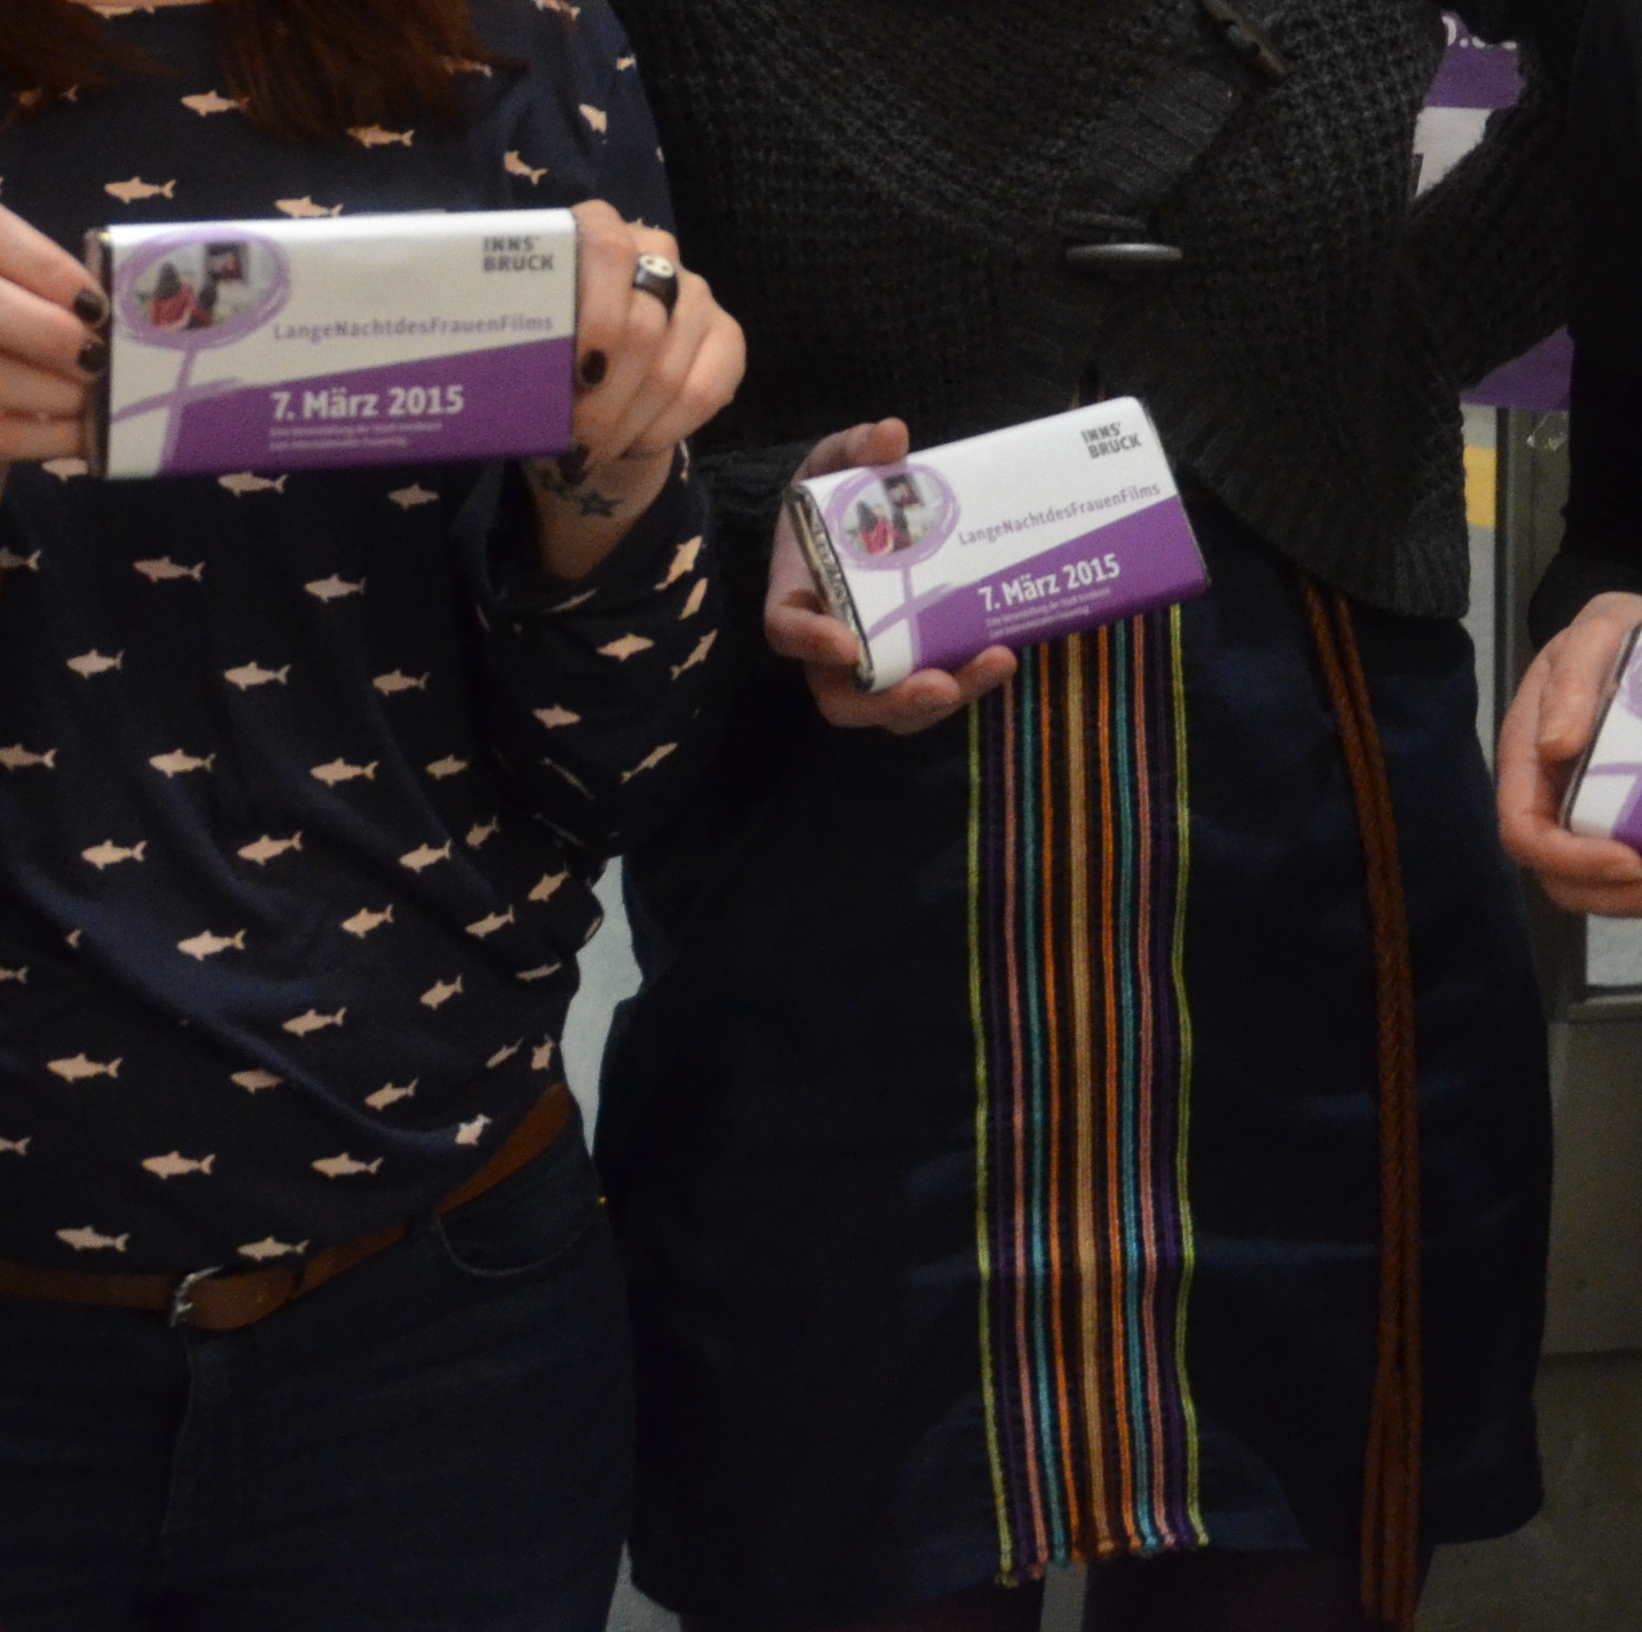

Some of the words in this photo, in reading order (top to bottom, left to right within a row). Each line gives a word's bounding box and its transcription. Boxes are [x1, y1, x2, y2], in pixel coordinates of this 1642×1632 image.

[483, 254, 555, 274] BRUCK
[269, 390, 296, 422] 7.
[302, 385, 380, 419] März
[388, 383, 465, 416] 2015
[1088, 433, 1142, 460] BRUCK
[958, 483, 1161, 546] LangeNachtdesFrauenFilms
[977, 585, 1001, 612] 7.
[1001, 572, 1061, 607] März
[1062, 552, 1121, 591] 2015
